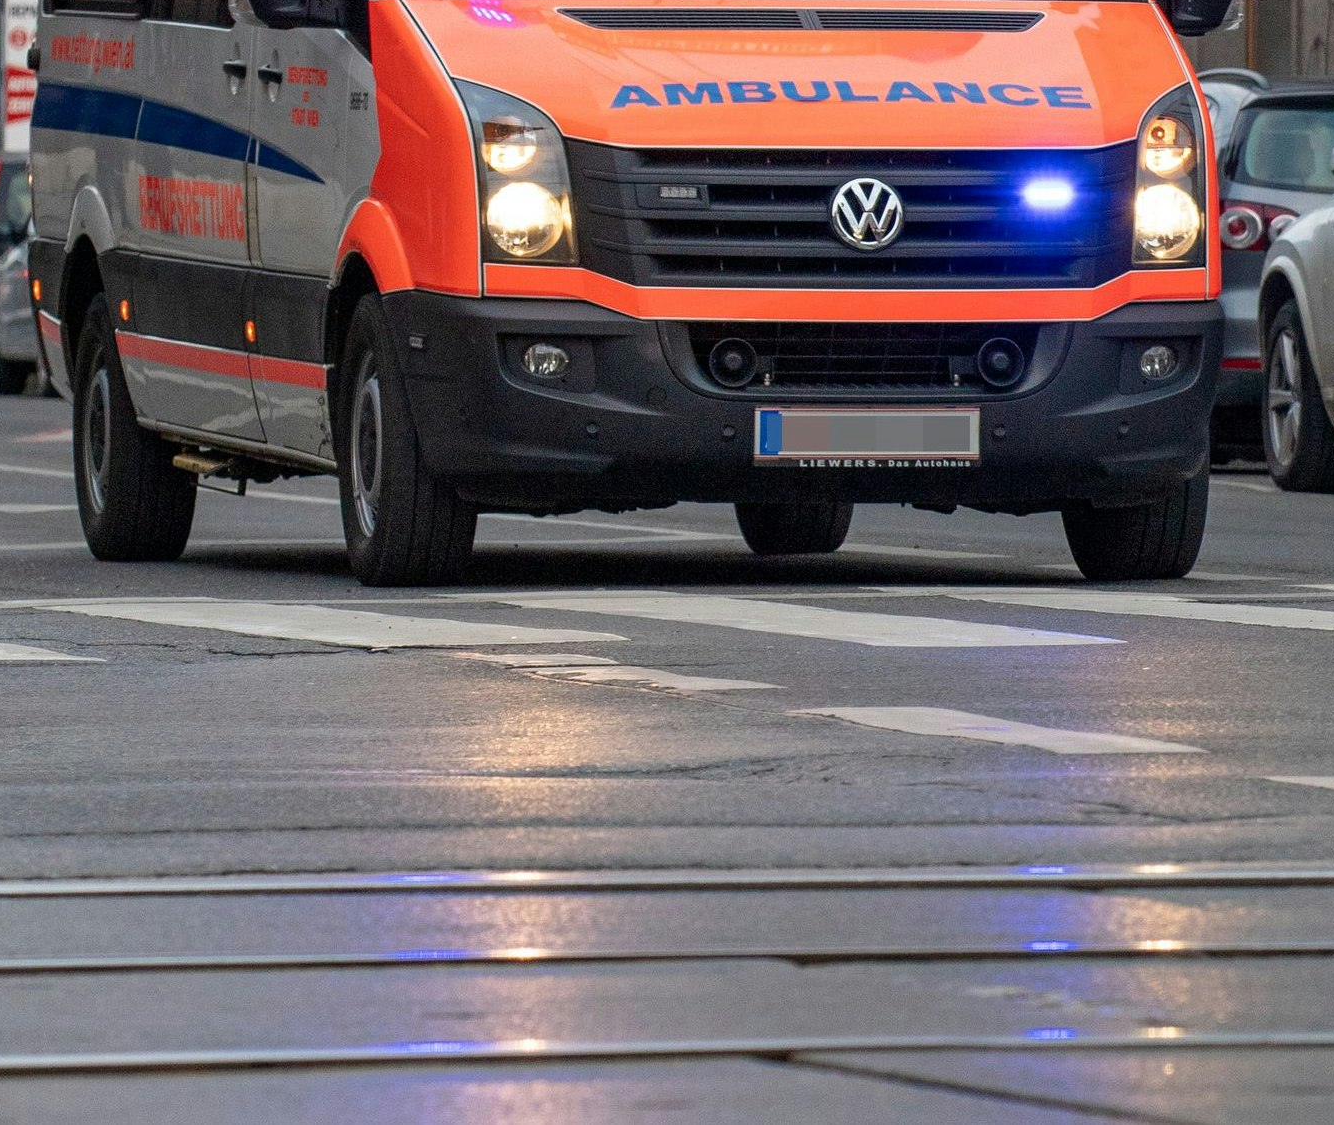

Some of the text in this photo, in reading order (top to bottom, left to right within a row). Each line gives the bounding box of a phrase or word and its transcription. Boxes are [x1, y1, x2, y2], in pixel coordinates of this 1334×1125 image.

[609, 80, 1092, 109] AMBULANCE
[799, 459, 971, 468] LIEWERS. Das Autohaus
